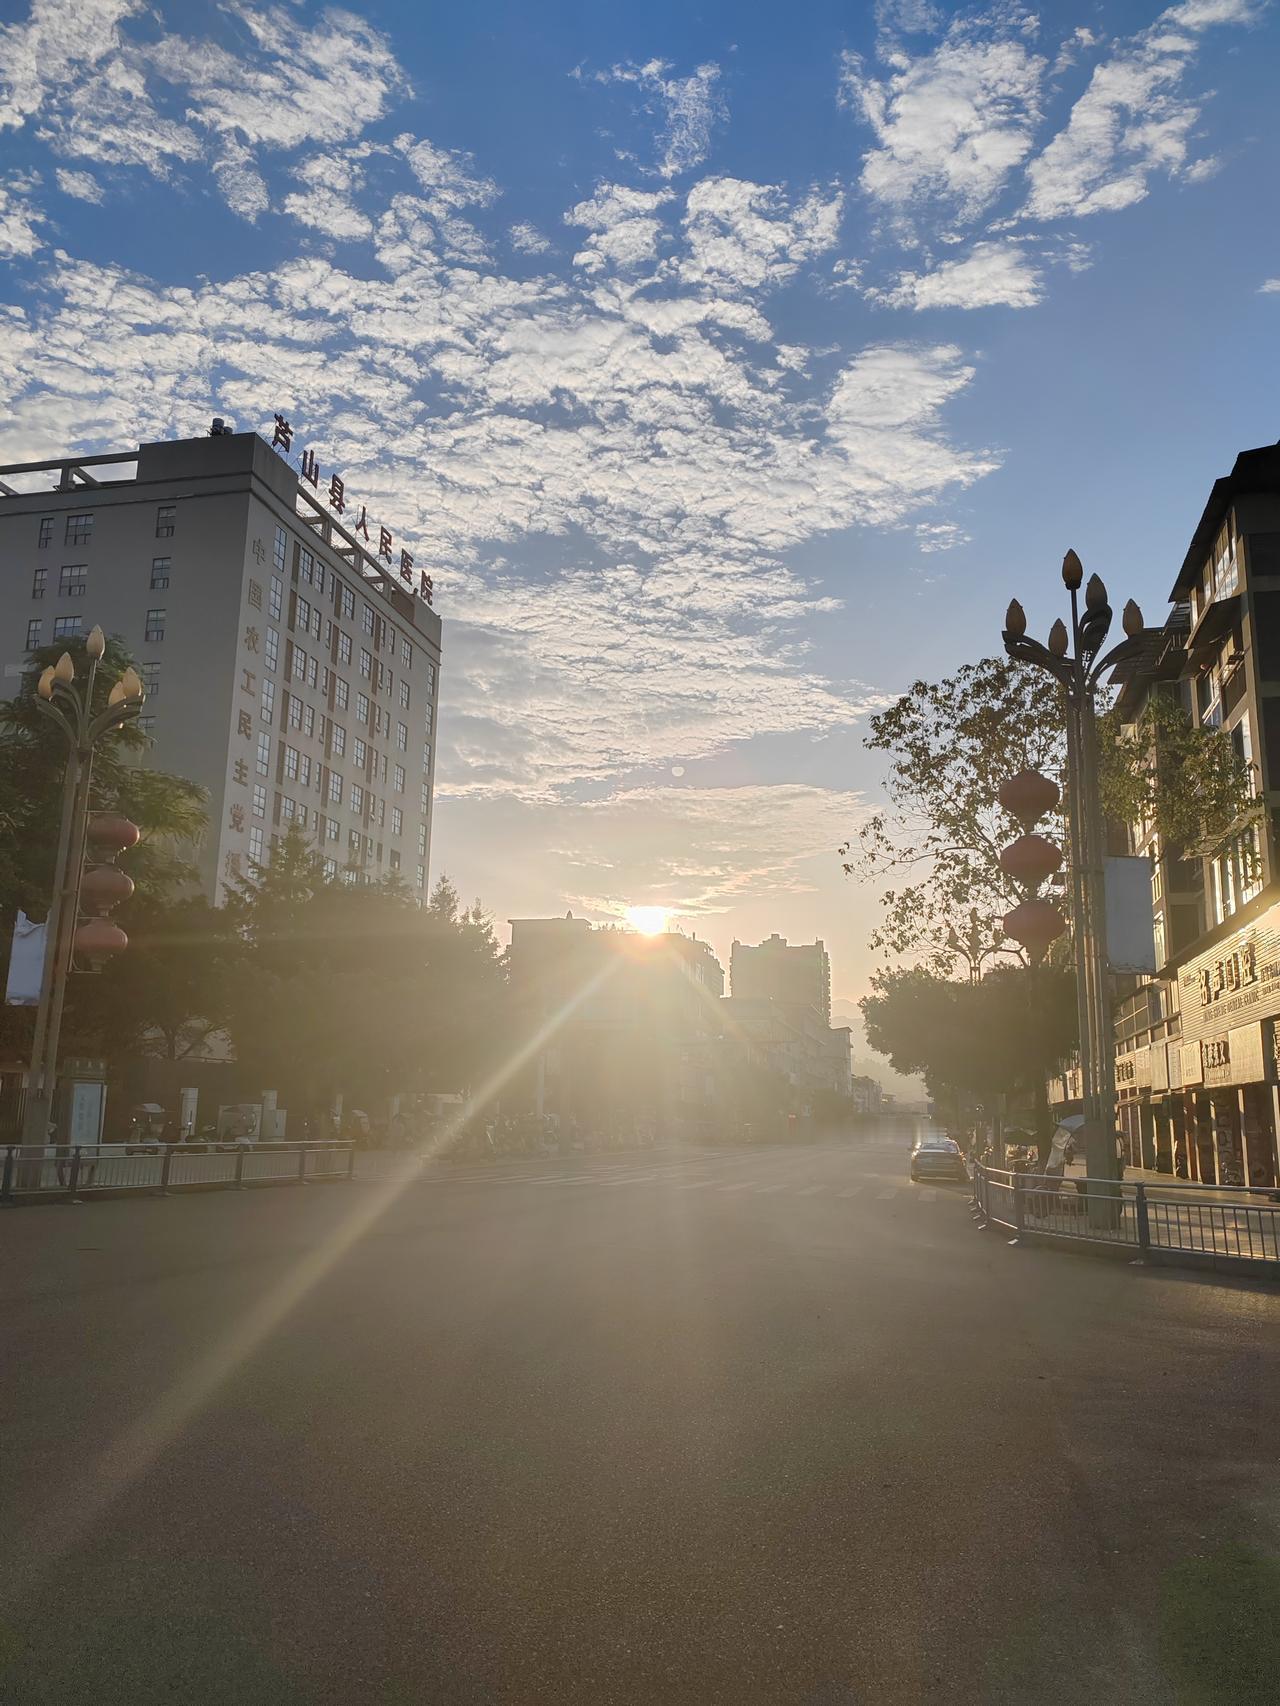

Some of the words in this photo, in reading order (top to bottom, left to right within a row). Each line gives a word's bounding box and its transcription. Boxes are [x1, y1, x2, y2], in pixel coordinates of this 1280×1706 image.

[272, 413, 433, 606] 芦山县人民医院
